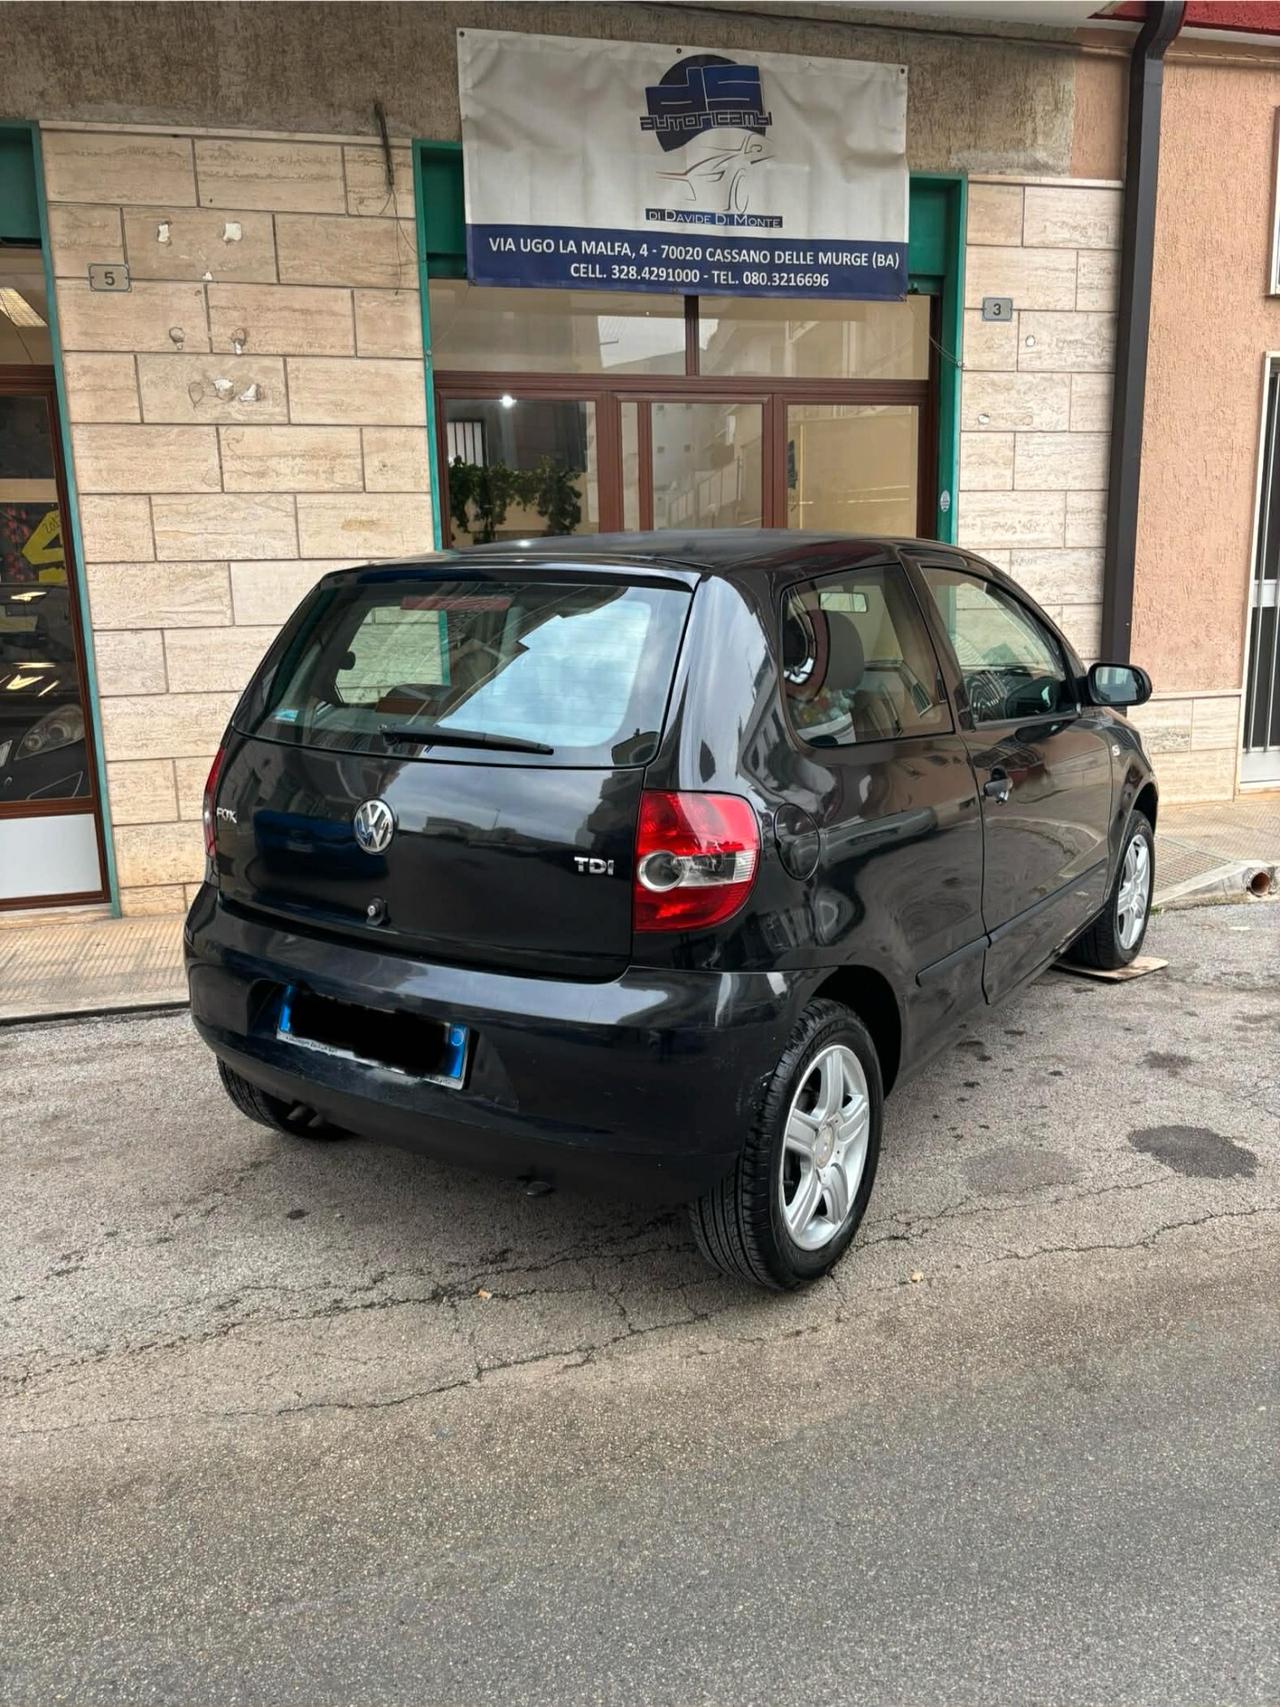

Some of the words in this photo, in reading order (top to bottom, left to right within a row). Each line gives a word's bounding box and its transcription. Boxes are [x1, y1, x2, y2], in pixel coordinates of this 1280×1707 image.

[489, 237, 516, 252] VIA
[520, 239, 555, 253] UGO
[559, 240, 577, 254] LA
[581, 240, 636, 259] MALFA,
[639, 243, 648, 257] 4
[661, 245, 702, 261] 70020
[706, 248, 770, 264] CASSANO
[775, 251, 814, 265] DELLE
[819, 252, 869, 266] MURGE
[872, 252, 899, 269] (BA)
[104, 271, 115, 286] 5
[570, 263, 606, 278] CELL.
[611, 265, 700, 283] 328.4291000
[712, 271, 739, 285] TEL.
[743, 272, 829, 287] 080.3216696
[993, 303, 1001, 316] 3
[573, 856, 615, 876] TDI
